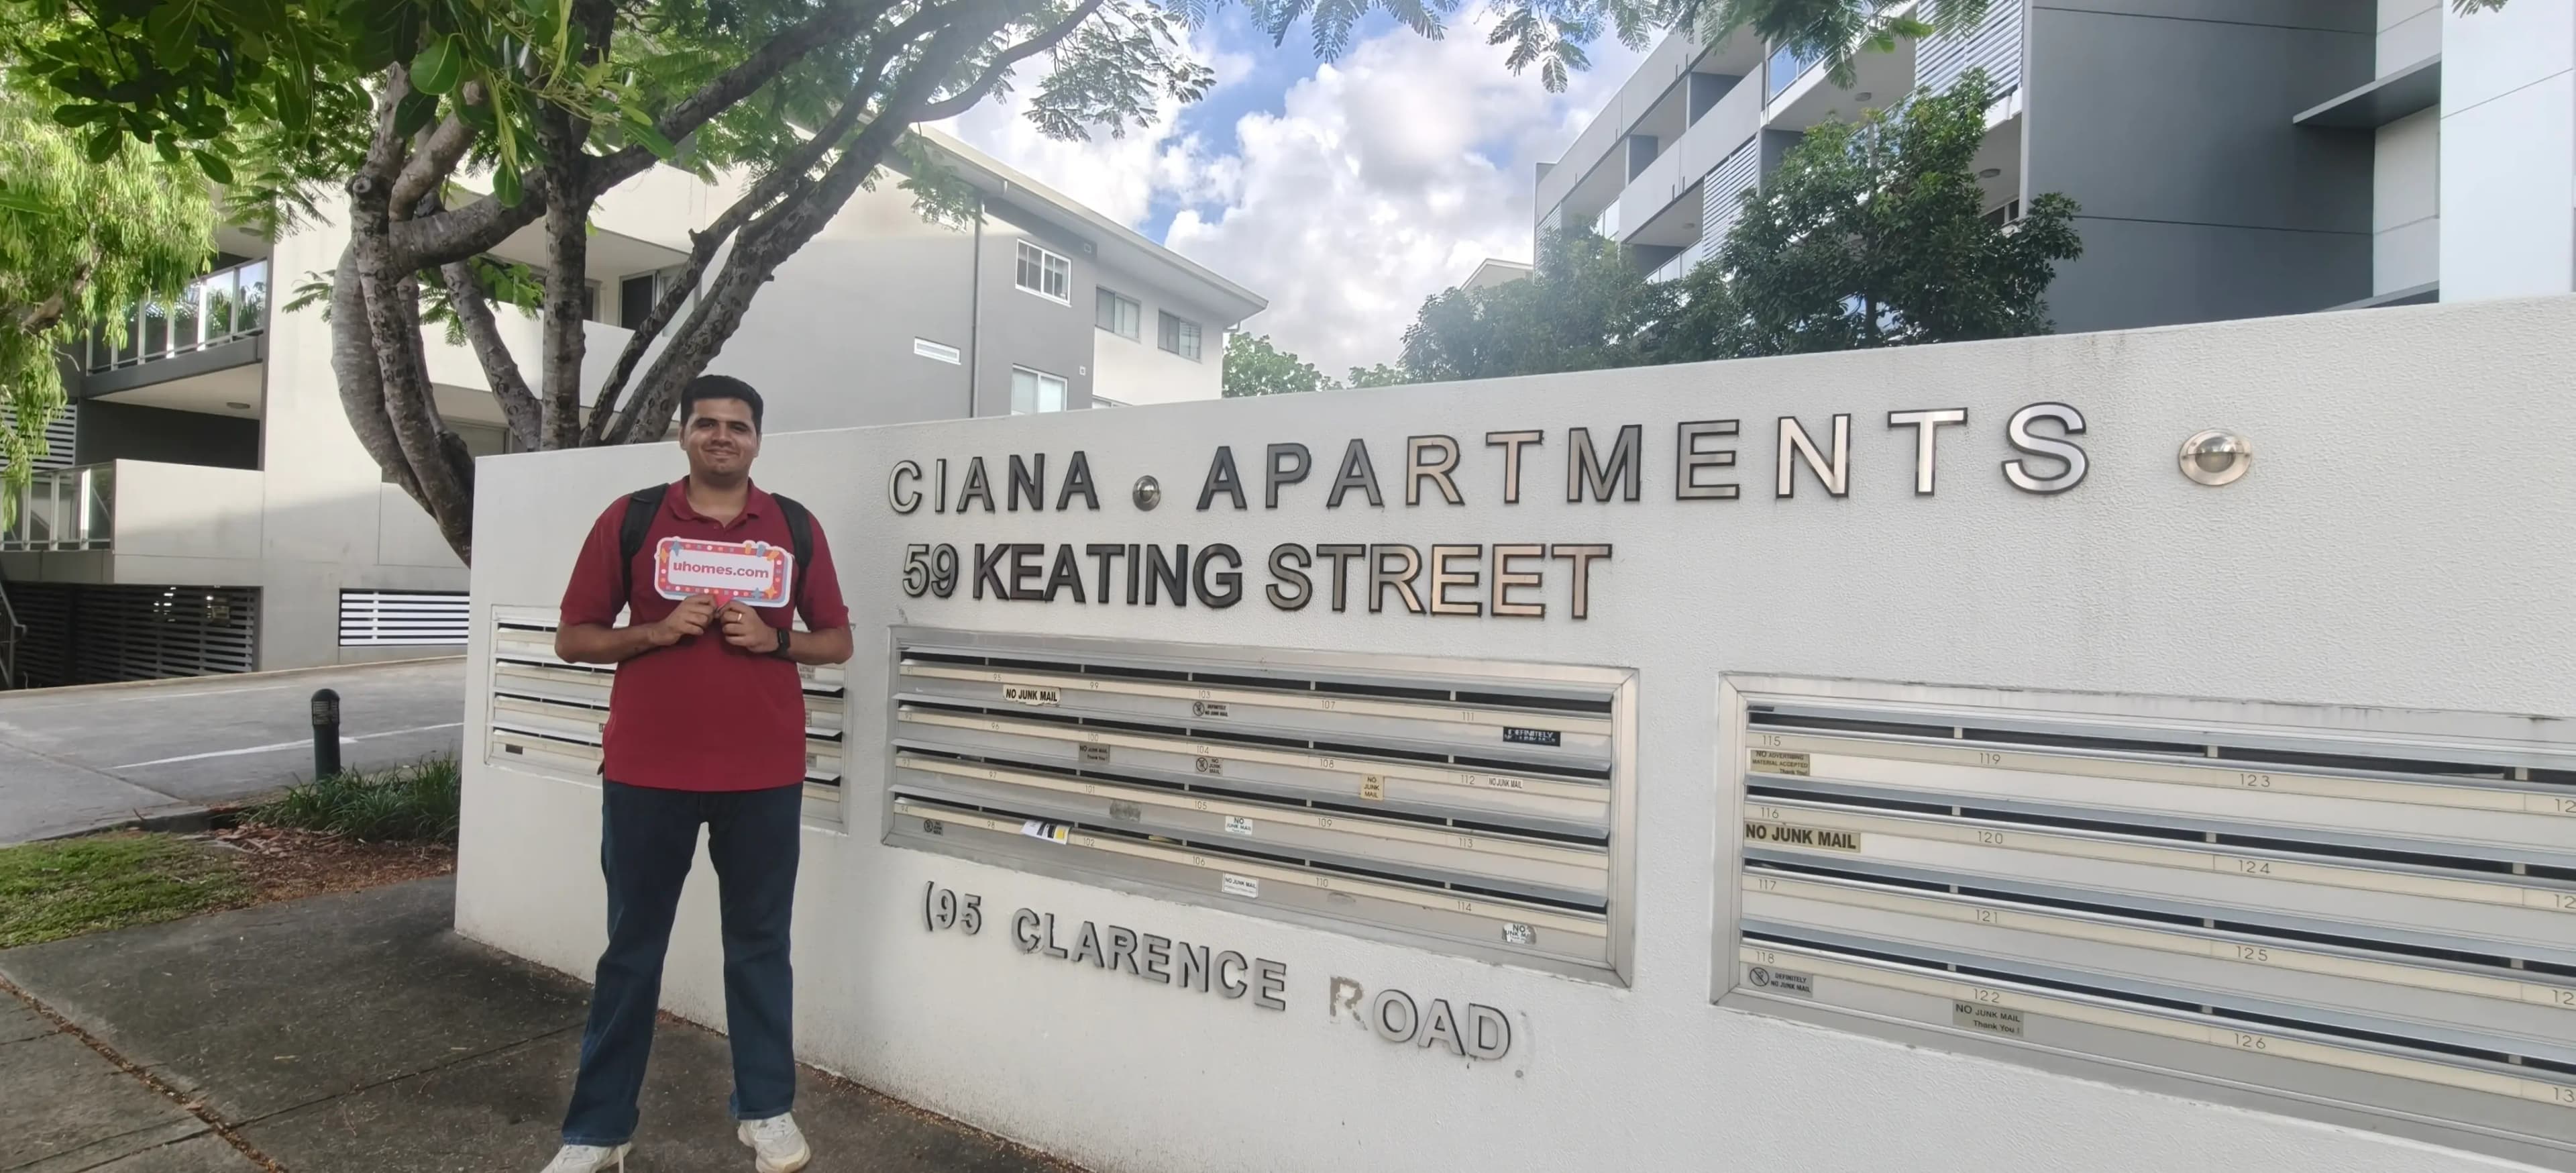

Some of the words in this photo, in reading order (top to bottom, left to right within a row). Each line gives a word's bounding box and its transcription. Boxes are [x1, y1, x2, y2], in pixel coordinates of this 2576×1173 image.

[888, 450, 1101, 514] CIANA
[1196, 402, 2089, 511] APARTMENTS
[673, 561, 770, 578] uhomes.com
[902, 544, 959, 598] 59
[973, 544, 1243, 608] KEATING
[1266, 543, 1612, 620] STREET
[1006, 688, 1016, 699] NO
[1018, 689, 1038, 700] JUNK
[1040, 691, 1057, 702] MAIL
[1198, 690, 1211, 699] 103
[1322, 700, 1336, 709] 107
[1462, 712, 1474, 721] 111
[991, 723, 1000, 731] 96
[1087, 733, 1099, 742] 100
[1762, 735, 1780, 746] 115
[1197, 745, 1209, 754] 104
[1320, 758, 1334, 768] 108
[1980, 752, 2000, 764] 119
[989, 771, 997, 779] 97
[1461, 774, 1474, 784] 112
[1489, 778, 1496, 786] NO
[1497, 778, 1509, 787] JUNK
[1511, 780, 1522, 788] MAIL
[2240, 774, 2270, 788] 123
[1085, 785, 1095, 794] 101
[1195, 801, 1207, 810] 105
[1760, 807, 1778, 819] 116
[987, 821, 995, 829] 98
[1318, 817, 1332, 827] 109
[1083, 838, 1095, 847] 102
[1459, 837, 1473, 848] 113
[1746, 824, 1766, 839] NO
[1772, 826, 1813, 845] JUNK
[1817, 831, 1856, 850] MAIL
[1978, 831, 2003, 844] 120
[1193, 856, 1205, 866] 106
[2239, 860, 2270, 874] 124
[1316, 877, 1328, 887] 110
[1758, 878, 1776, 890] 117
[1457, 901, 1471, 912] 114
[1976, 909, 1998, 924] 121
[1513, 923, 1525, 933] NO
[922, 880, 981, 935] (95
[1012, 907, 1287, 1011] CLARENCE
[1757, 951, 1774, 964] 118
[2236, 945, 2267, 962] 125
[1775, 972, 1807, 983] DEFINITELY
[1780, 982, 1795, 990] JUNK
[1796, 985, 1811, 993] MAIL
[1974, 988, 2000, 1003] 122
[1955, 1003, 1972, 1014] NO
[1975, 1009, 1997, 1018] JUNK
[2000, 1013, 2021, 1022] MAIL
[1974, 1020, 1997, 1031] Thank
[2235, 1033, 2266, 1049] 126
